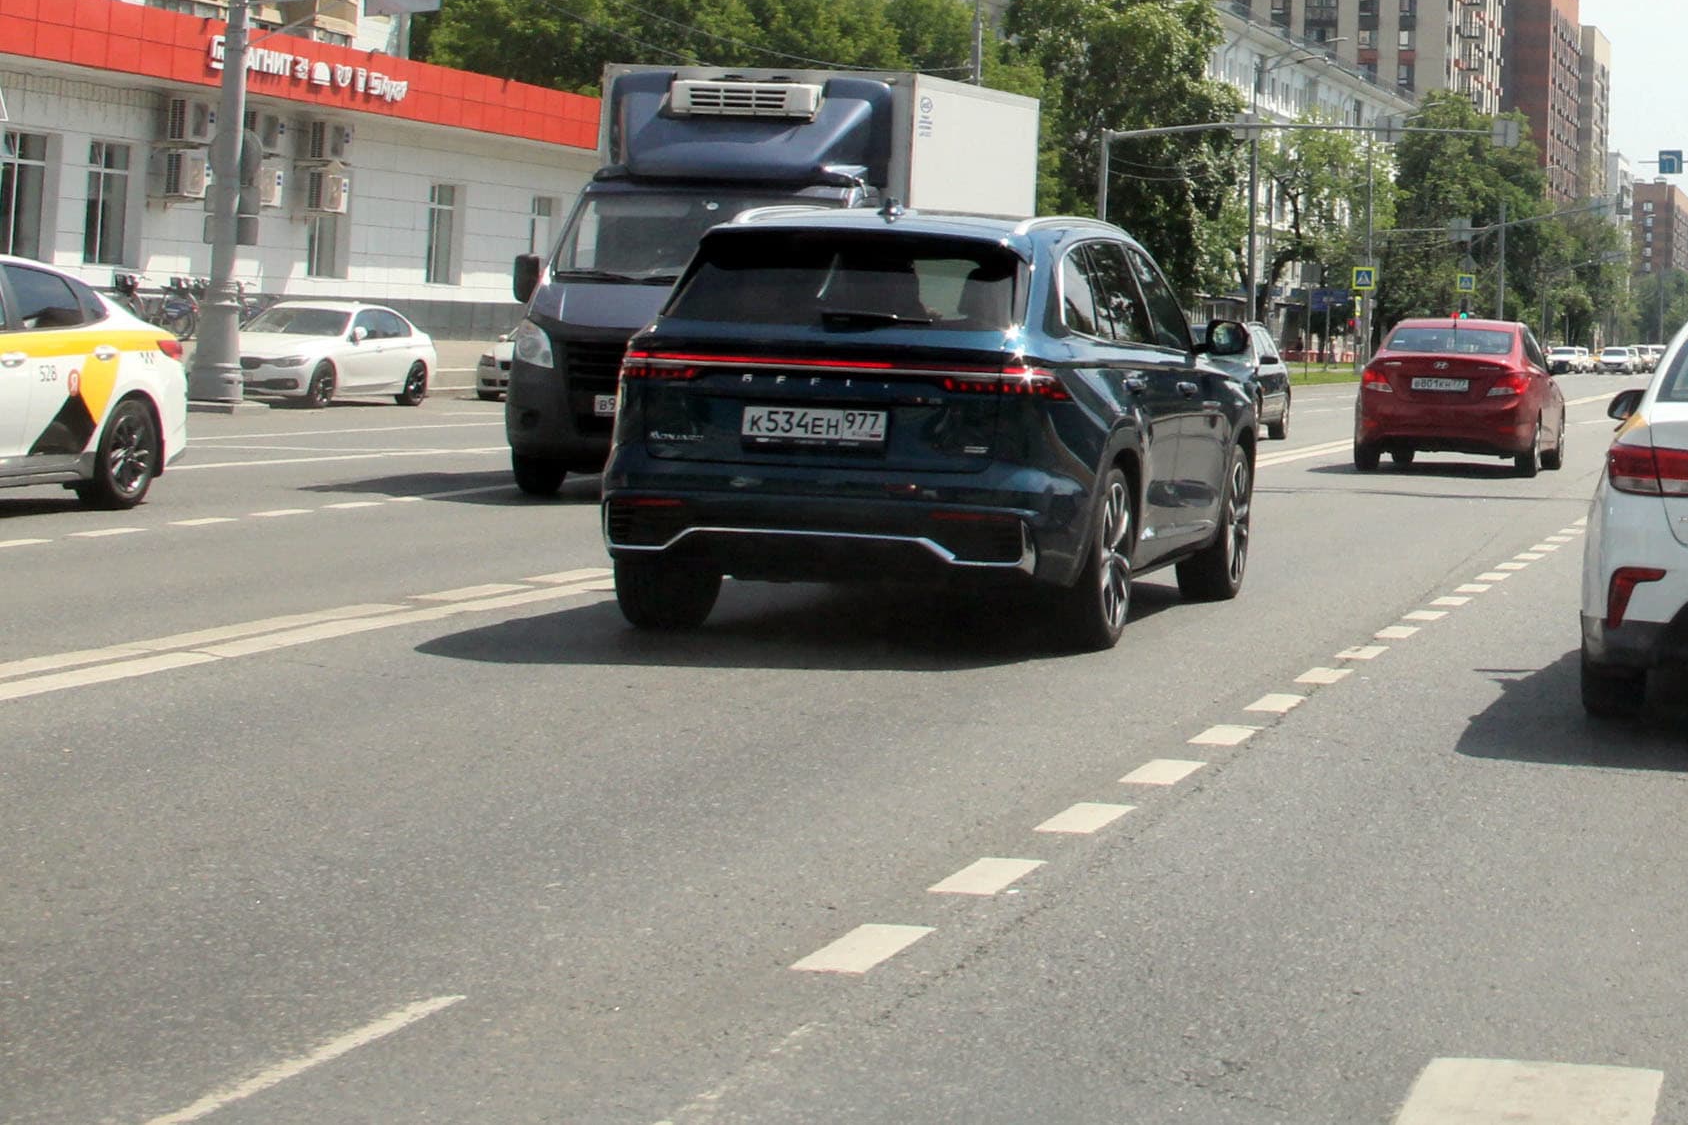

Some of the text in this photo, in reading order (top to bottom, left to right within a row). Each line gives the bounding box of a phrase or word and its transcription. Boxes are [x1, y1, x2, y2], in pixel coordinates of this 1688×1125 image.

[246, 47, 294, 77] АГНИТ
[750, 411, 880, 436] К534ЕН 977
